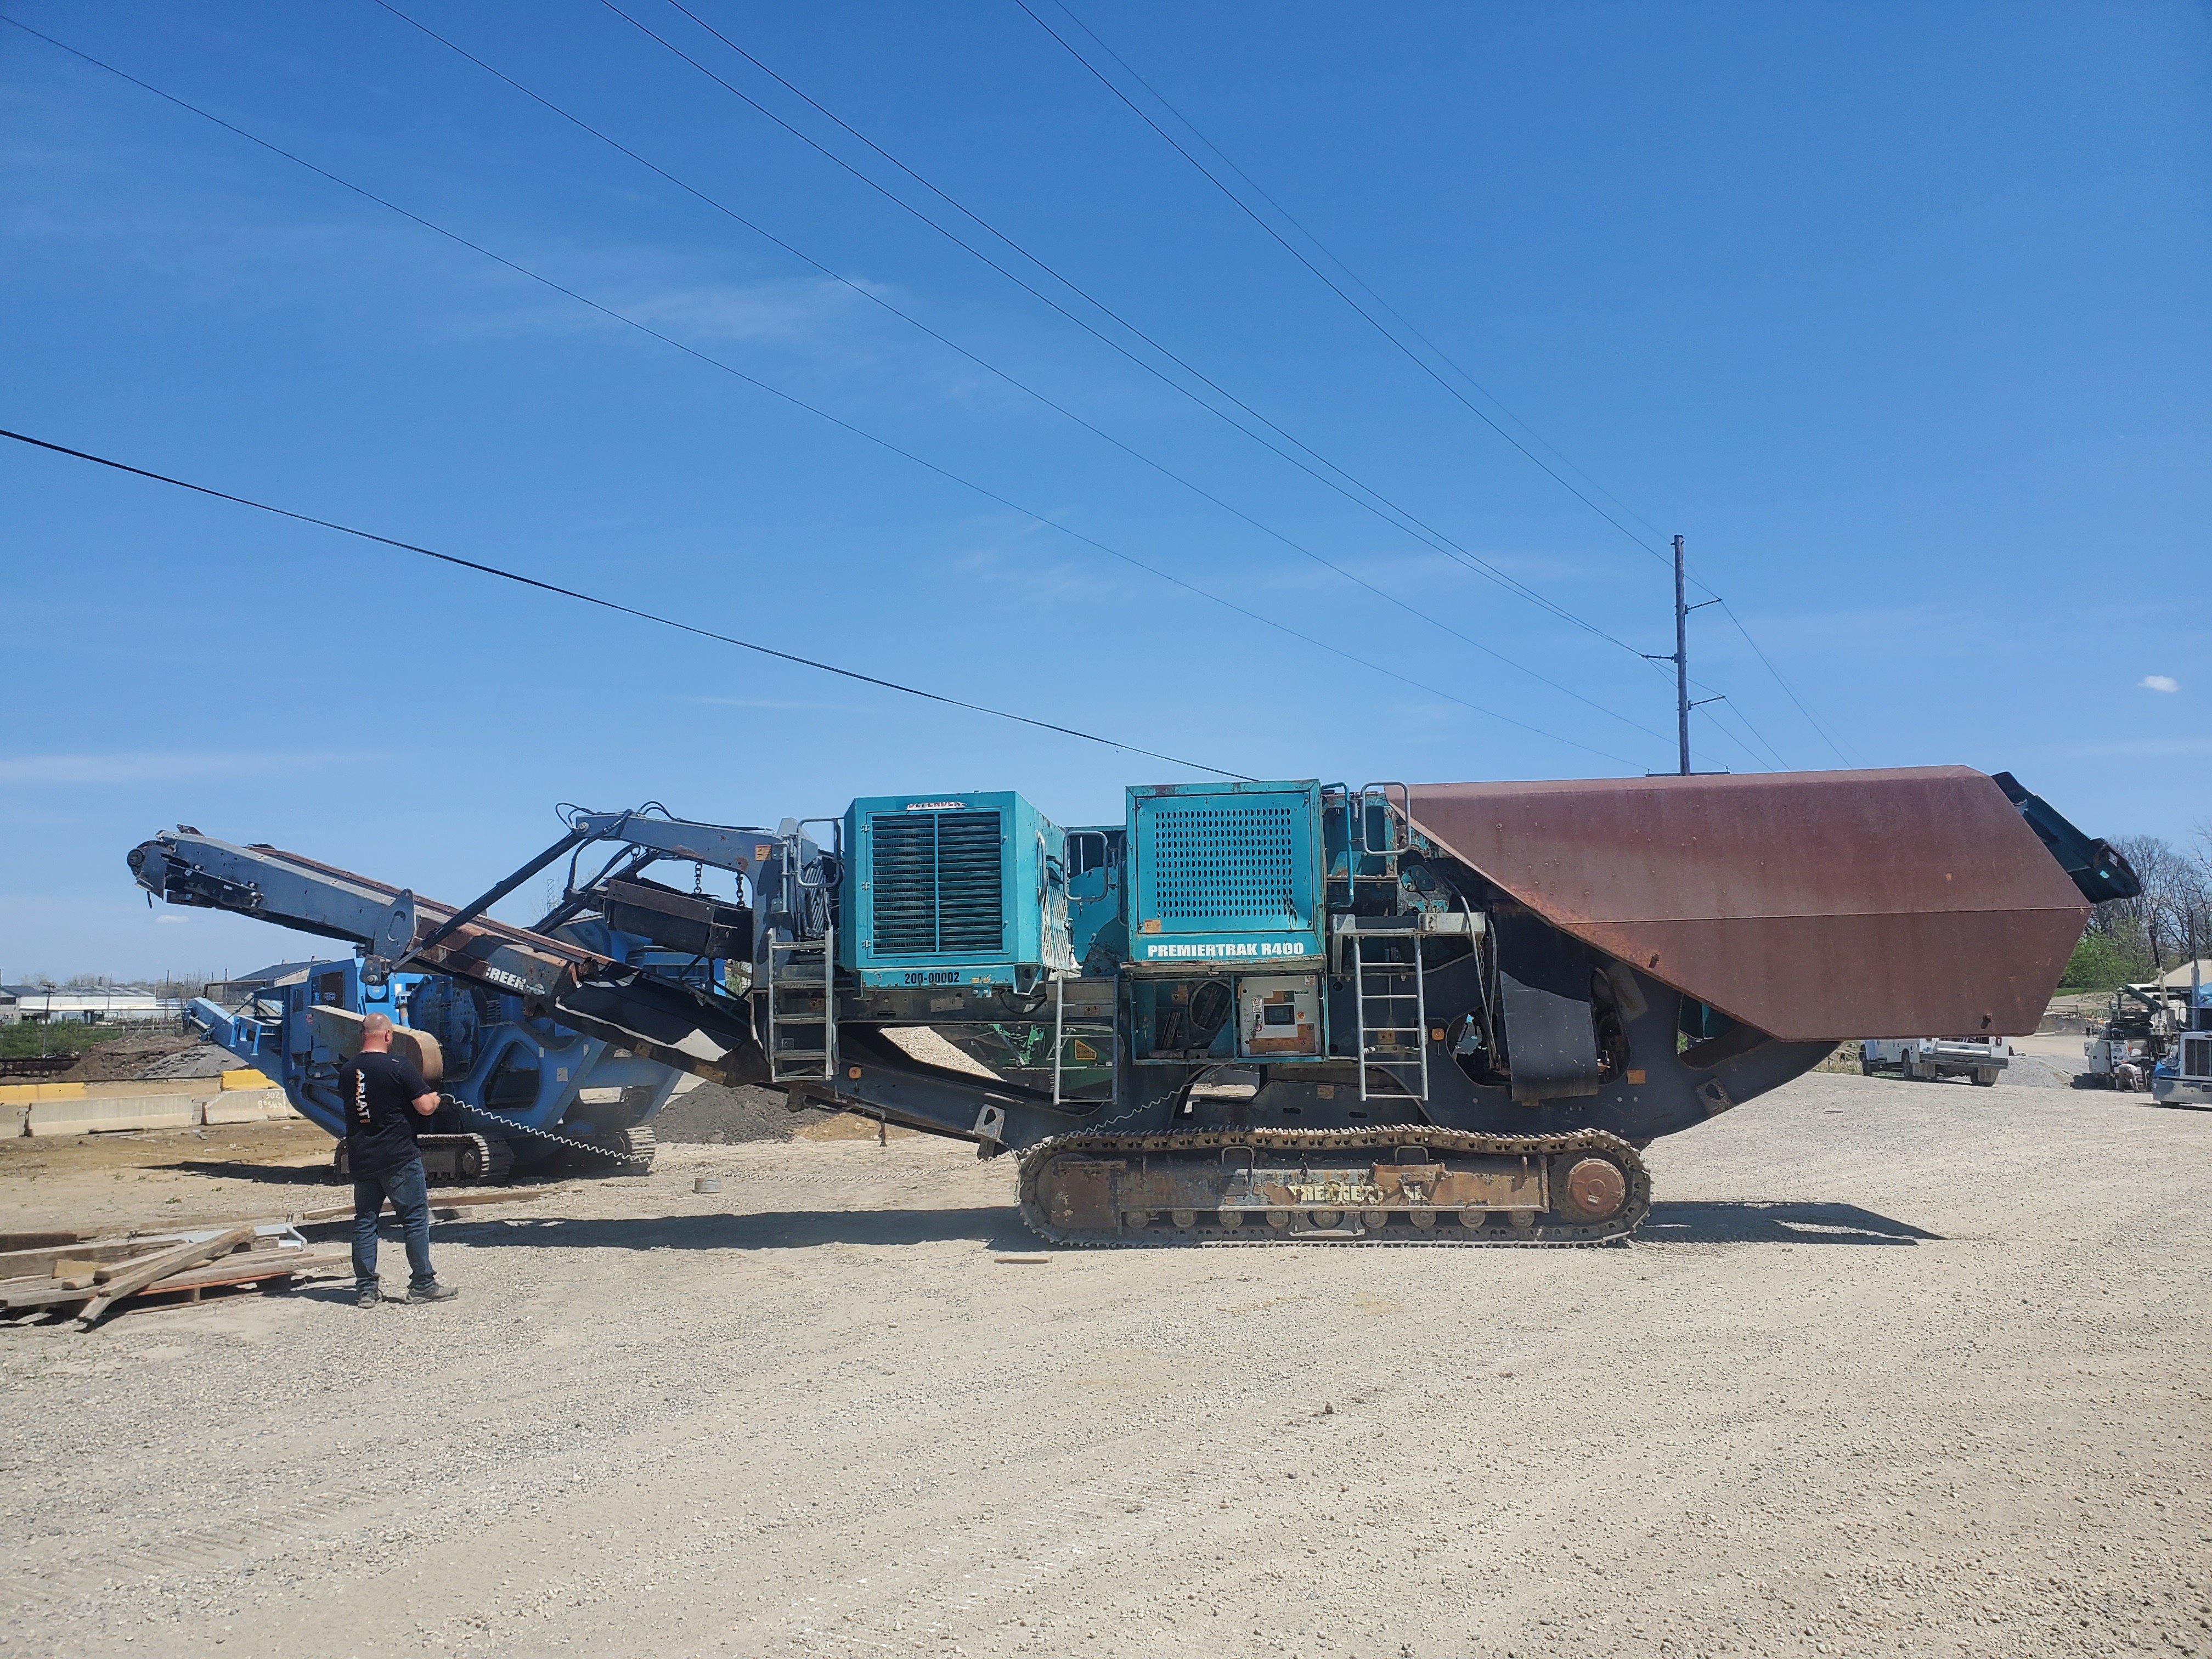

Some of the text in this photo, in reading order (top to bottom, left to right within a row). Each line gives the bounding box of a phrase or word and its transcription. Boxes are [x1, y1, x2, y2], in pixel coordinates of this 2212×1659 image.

[1148, 942, 1304, 957] PREMIERTRAK R400
[904, 971, 960, 984] 200-00002
[357, 1069, 370, 1120] ARIAT
